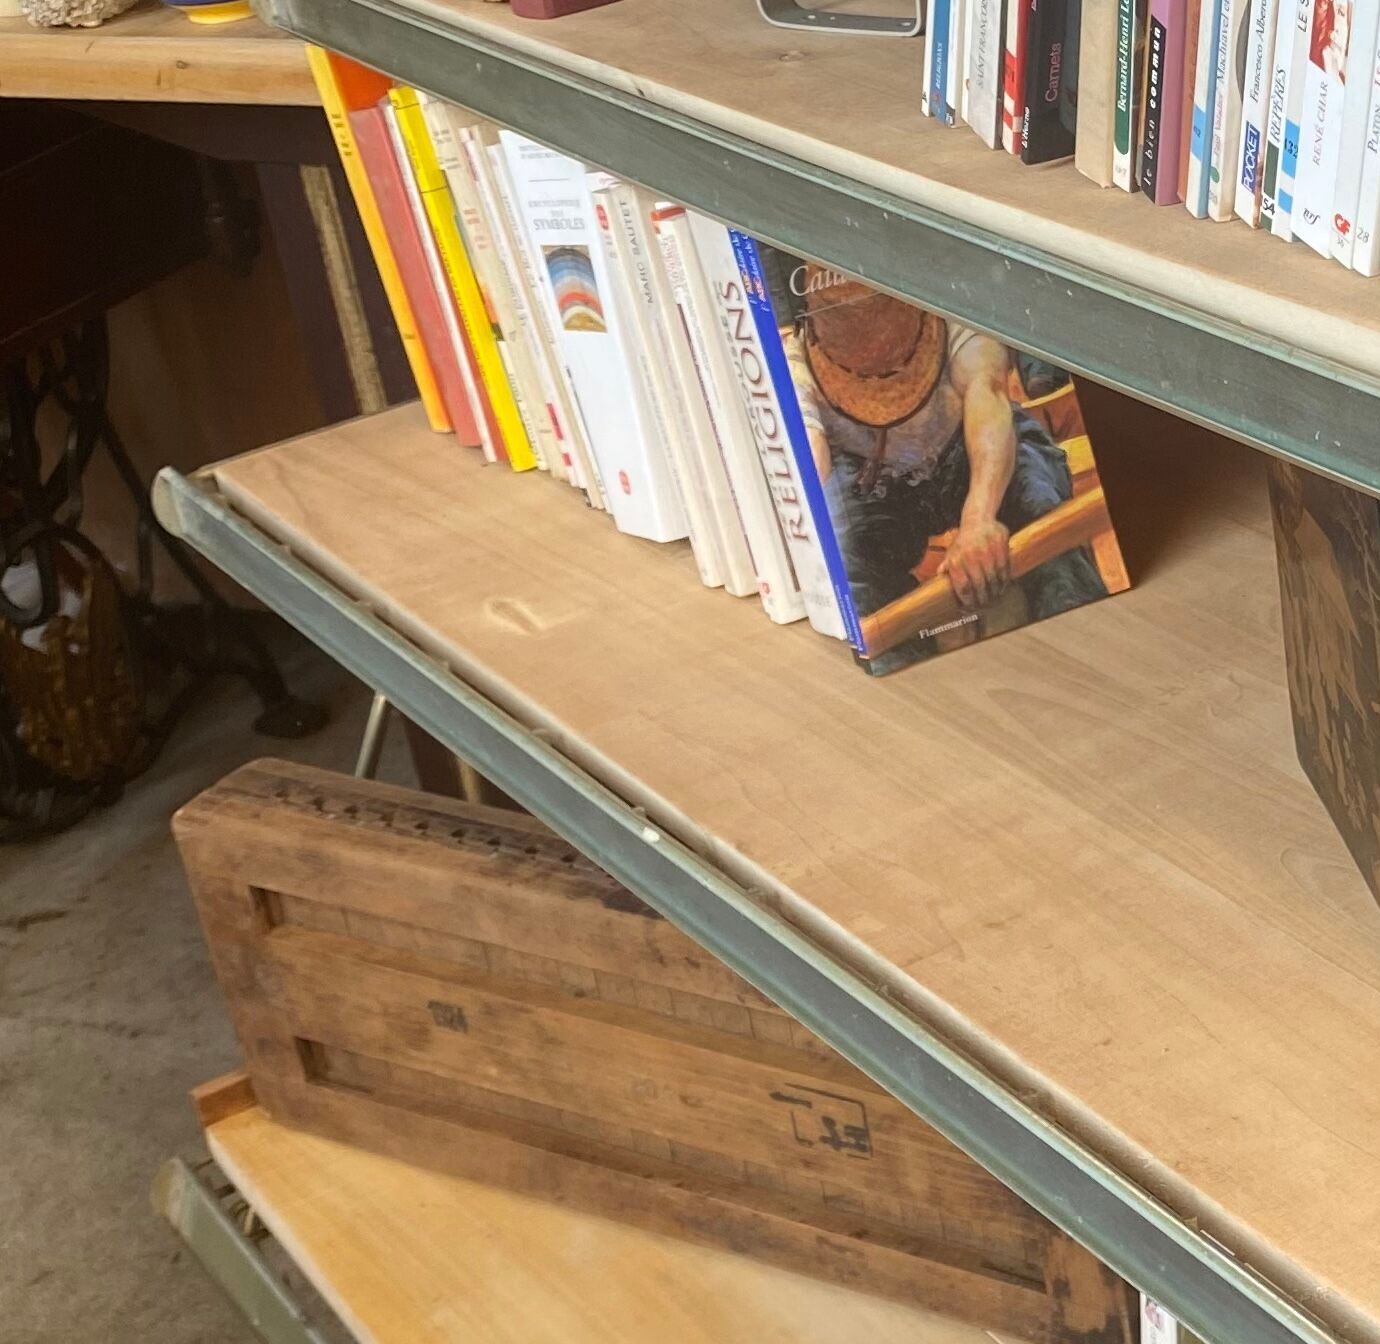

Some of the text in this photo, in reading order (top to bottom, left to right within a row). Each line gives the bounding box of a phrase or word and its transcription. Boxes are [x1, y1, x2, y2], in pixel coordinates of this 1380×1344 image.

[1217, 13, 1229, 85] Machiavel
[1297, 15, 1308, 33] LE
[1045, 42, 1062, 103] Carnets
[1117, 13, 1132, 113] Bernard-Henri
[1149, 25, 1161, 110] commun
[1250, 41, 1265, 105] Francesco
[1270, 67, 1287, 144] REPÈRES
[1242, 127, 1260, 192] POCKET
[723, 279, 810, 542] RELIGIONS
[919, 612, 979, 640] Flammarion
